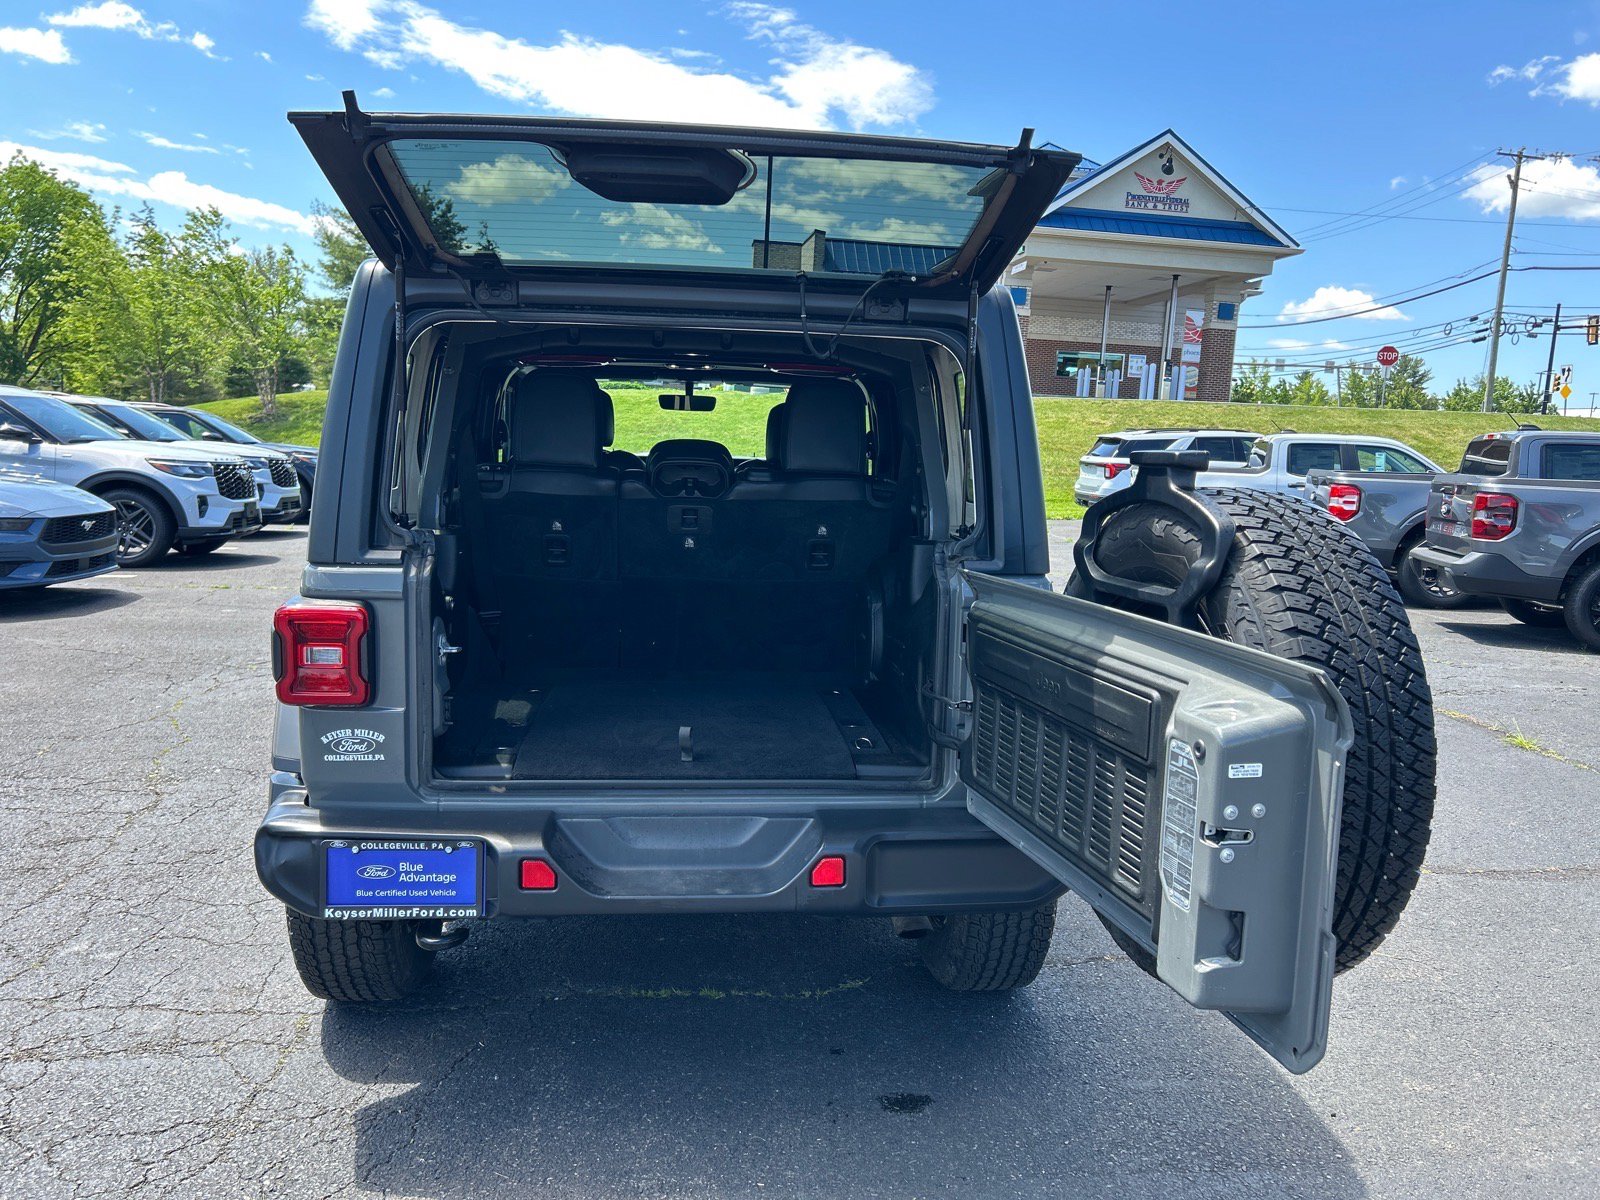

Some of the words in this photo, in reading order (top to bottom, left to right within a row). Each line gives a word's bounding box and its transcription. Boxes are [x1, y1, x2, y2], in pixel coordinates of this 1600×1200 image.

[1125, 200, 1149, 209] BANK
[1163, 203, 1190, 212] TRUST
[1378, 352, 1398, 360] STOP
[320, 729, 352, 744] KEYSER
[354, 729, 386, 743] MILLER
[339, 738, 368, 751] Ford
[361, 842, 428, 850] COLLEGEVILLE,
[431, 842, 444, 850] PA
[364, 866, 388, 877] Ford
[399, 862, 424, 872] Blue
[399, 872, 457, 884] Advantage
[356, 889, 373, 897] Blue
[375, 889, 407, 897] Certified
[408, 889, 428, 897] Used
[430, 889, 457, 897] Vehicle
[324, 907, 477, 920] KeyserMillerFord.com
